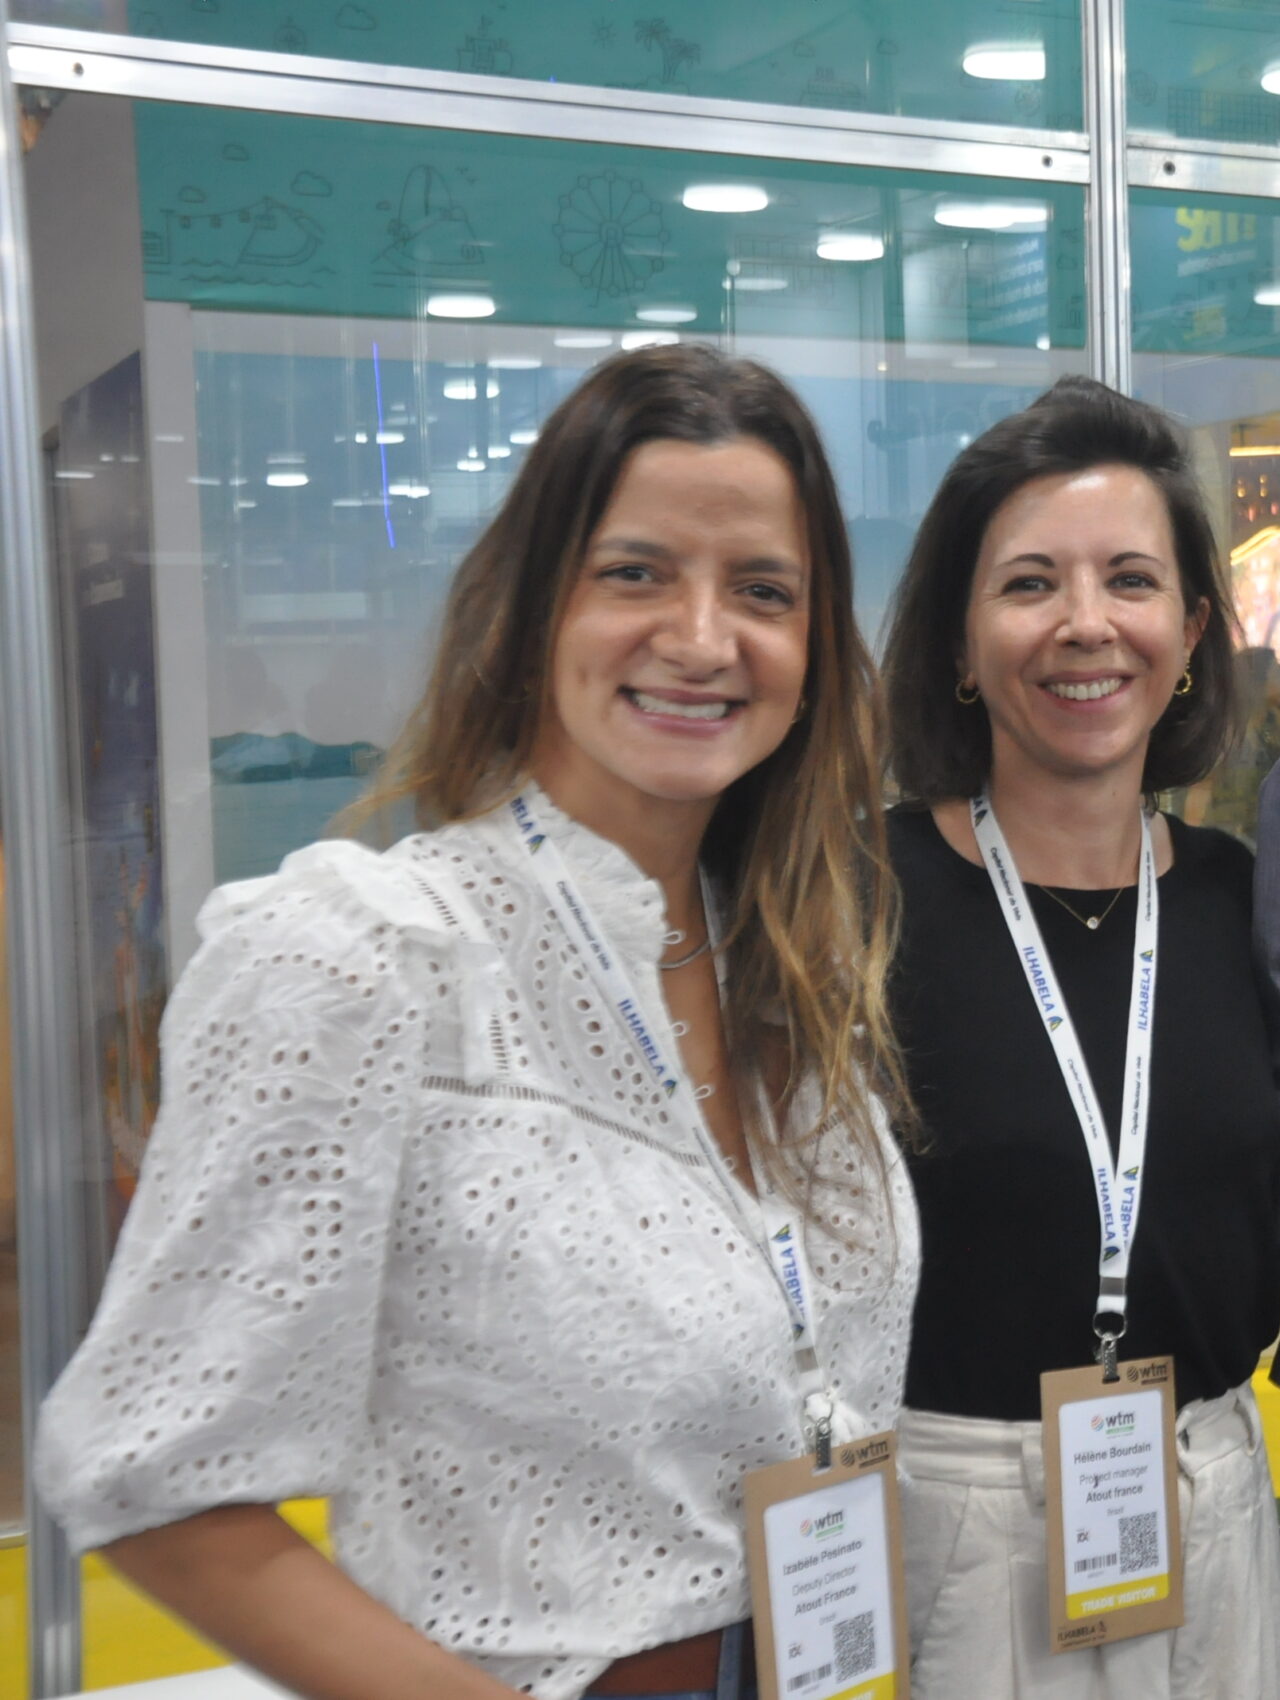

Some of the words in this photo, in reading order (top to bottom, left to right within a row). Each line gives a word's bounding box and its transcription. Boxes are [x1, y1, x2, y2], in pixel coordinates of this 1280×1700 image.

[1022, 946, 1055, 1013] ILHABELA
[1137, 967, 1154, 1031] ILHABELA
[618, 999, 666, 1077] ILHABELA
[1097, 1167, 1116, 1242] ILHABELA
[1140, 1362, 1168, 1377] wtm
[1105, 1410, 1135, 1428] wtm
[856, 1439, 889, 1459] wtm
[1073, 1450, 1107, 1464] Hélène
[1109, 1442, 1151, 1459] Bourdain
[1085, 1489, 1112, 1504] Atout
[1114, 1484, 1144, 1498] france
[814, 1509, 845, 1530] wtm
[820, 1539, 863, 1562] Pesinato
[792, 1577, 823, 1597] Deputy
[824, 1563, 857, 1585] Director
[794, 1597, 823, 1616] Atout
[824, 1584, 858, 1605] France
